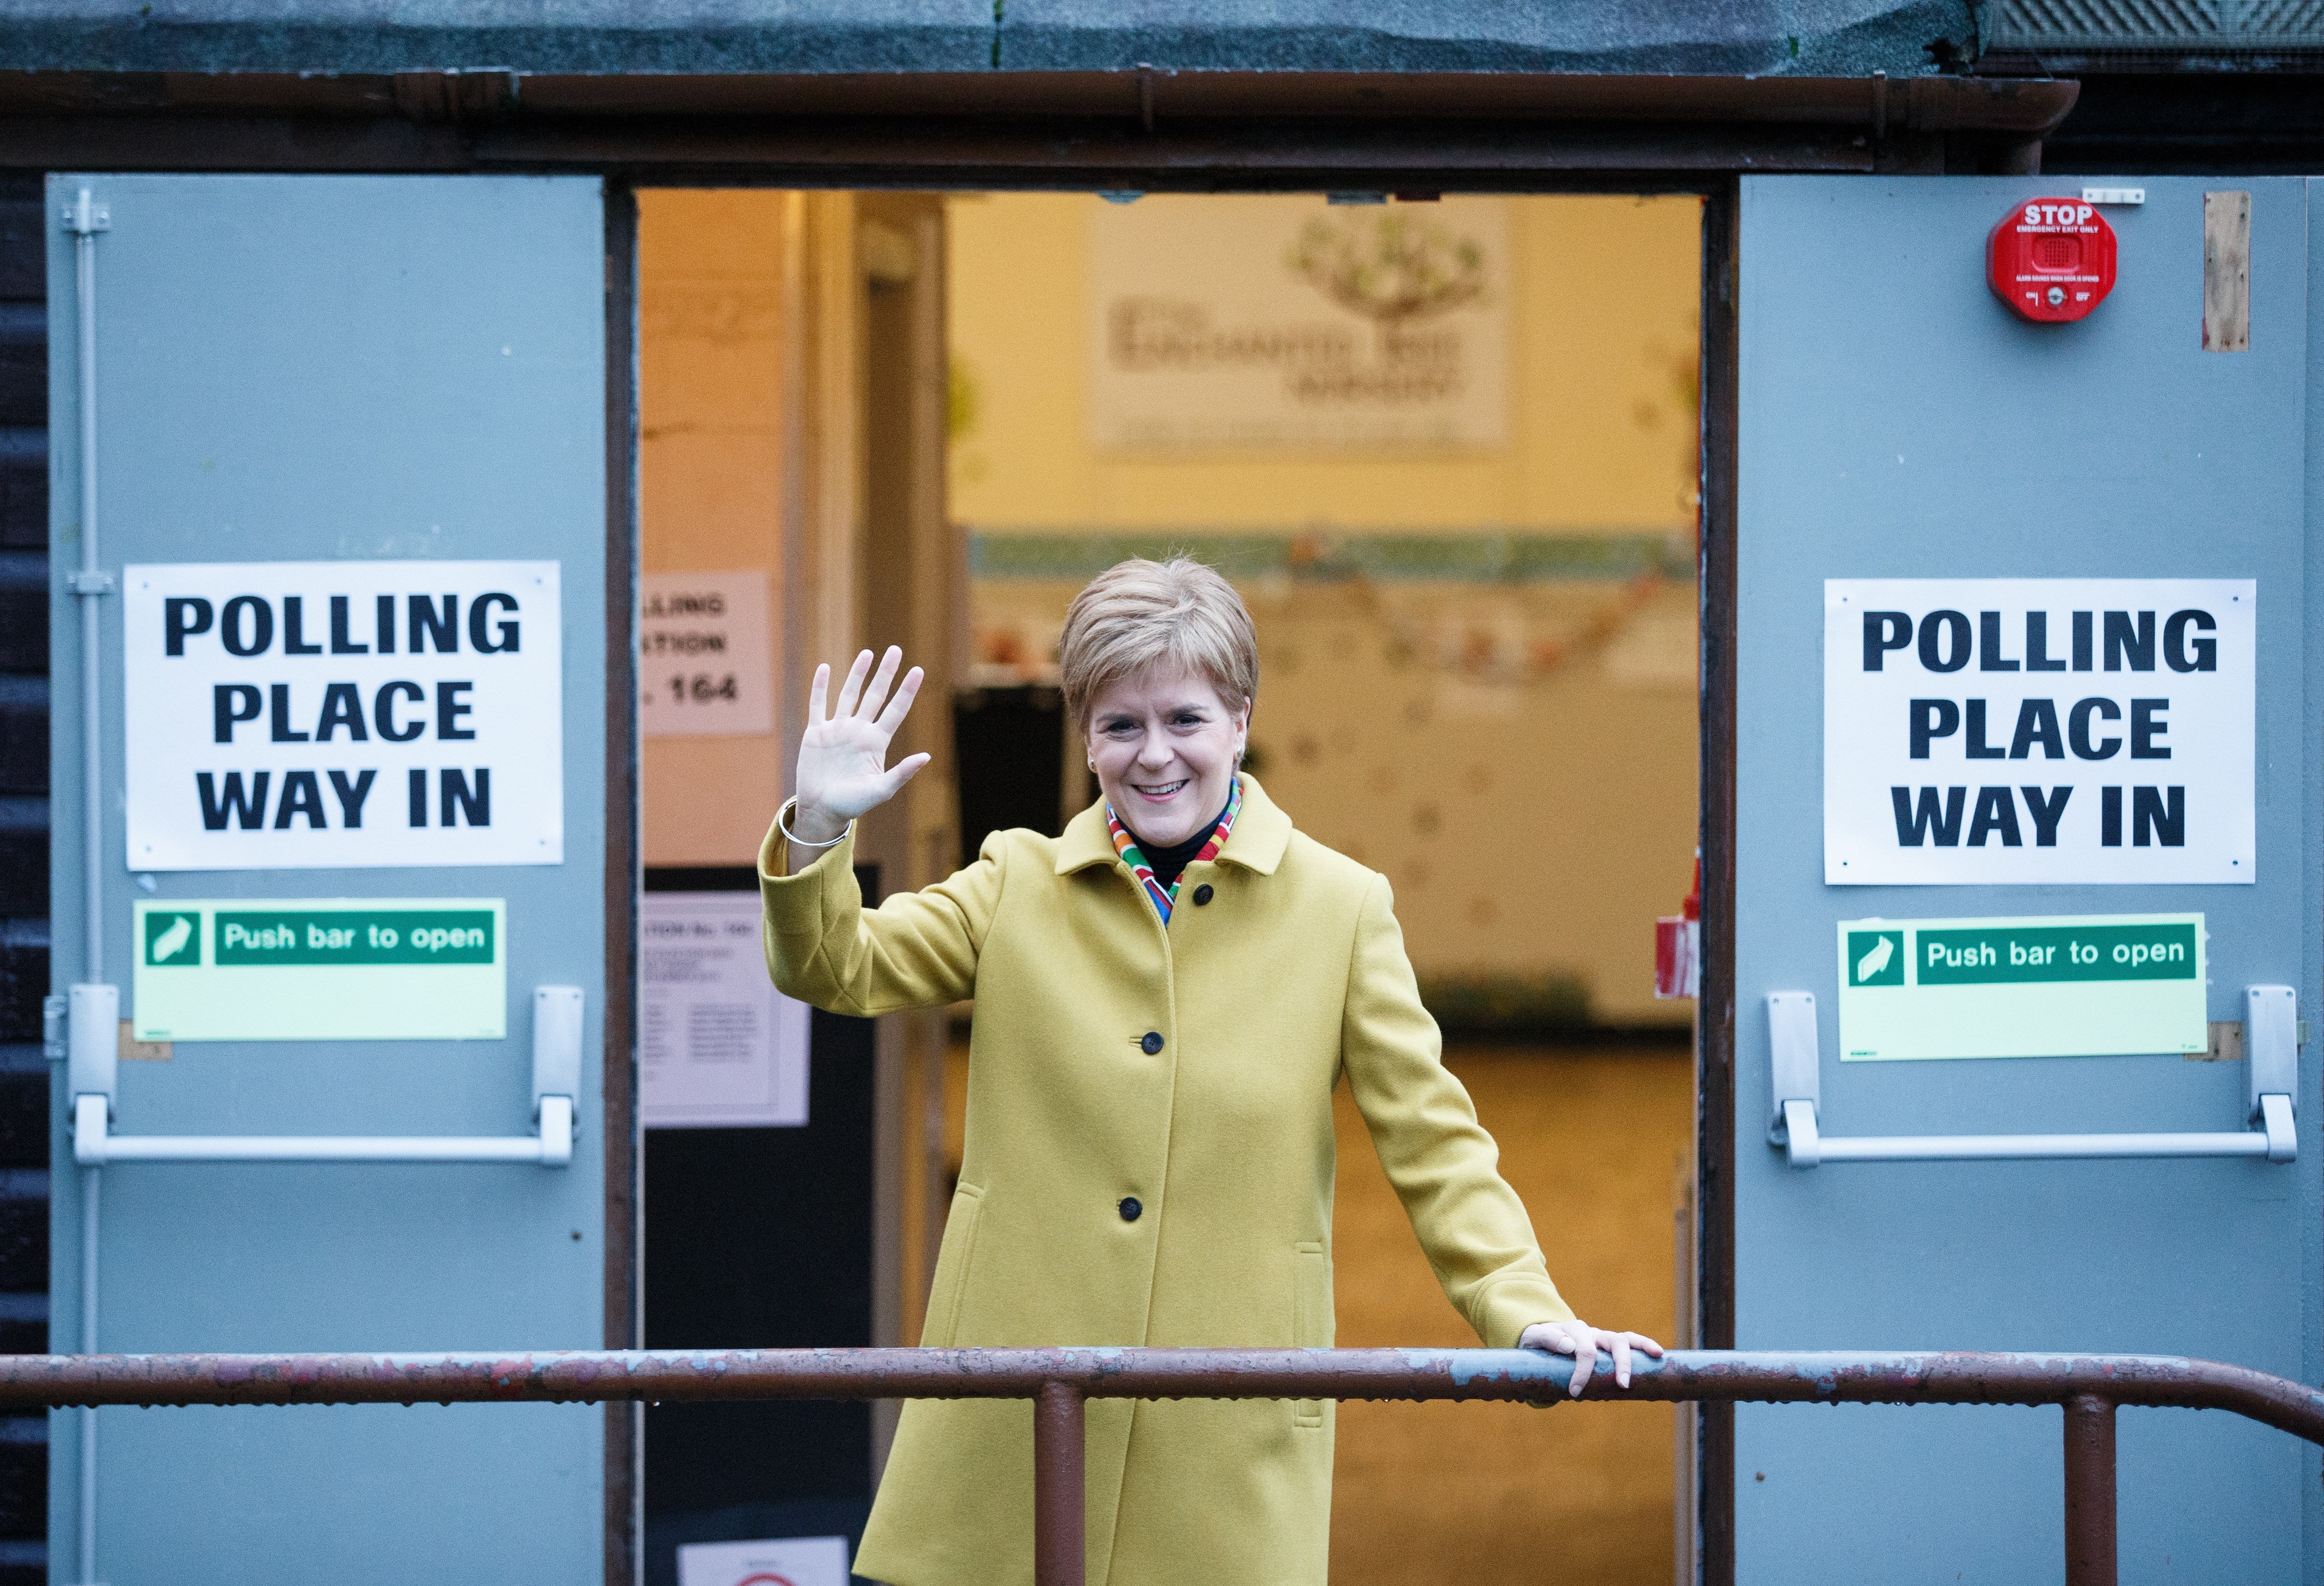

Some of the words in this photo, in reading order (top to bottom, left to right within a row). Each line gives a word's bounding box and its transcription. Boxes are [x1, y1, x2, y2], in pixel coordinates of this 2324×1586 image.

[2025, 204, 2093, 225] STOP
[165, 592, 520, 656] POLLING
[1862, 609, 2217, 672] POLLING
[214, 681, 475, 743] PLACE
[671, 674, 738, 703] 164
[1909, 697, 2171, 760] PLACE
[195, 770, 378, 830] WAY
[408, 768, 490, 827] IN
[1890, 786, 2073, 847] WAY
[2101, 786, 2185, 847] IN
[223, 923, 295, 950] Push
[307, 923, 355, 949] bar
[368, 924, 398, 948] to
[410, 923, 484, 953] open
[1928, 942, 1996, 967] Push
[2009, 941, 2055, 966] bar
[2069, 941, 2099, 965] to
[2112, 941, 2184, 967] open
